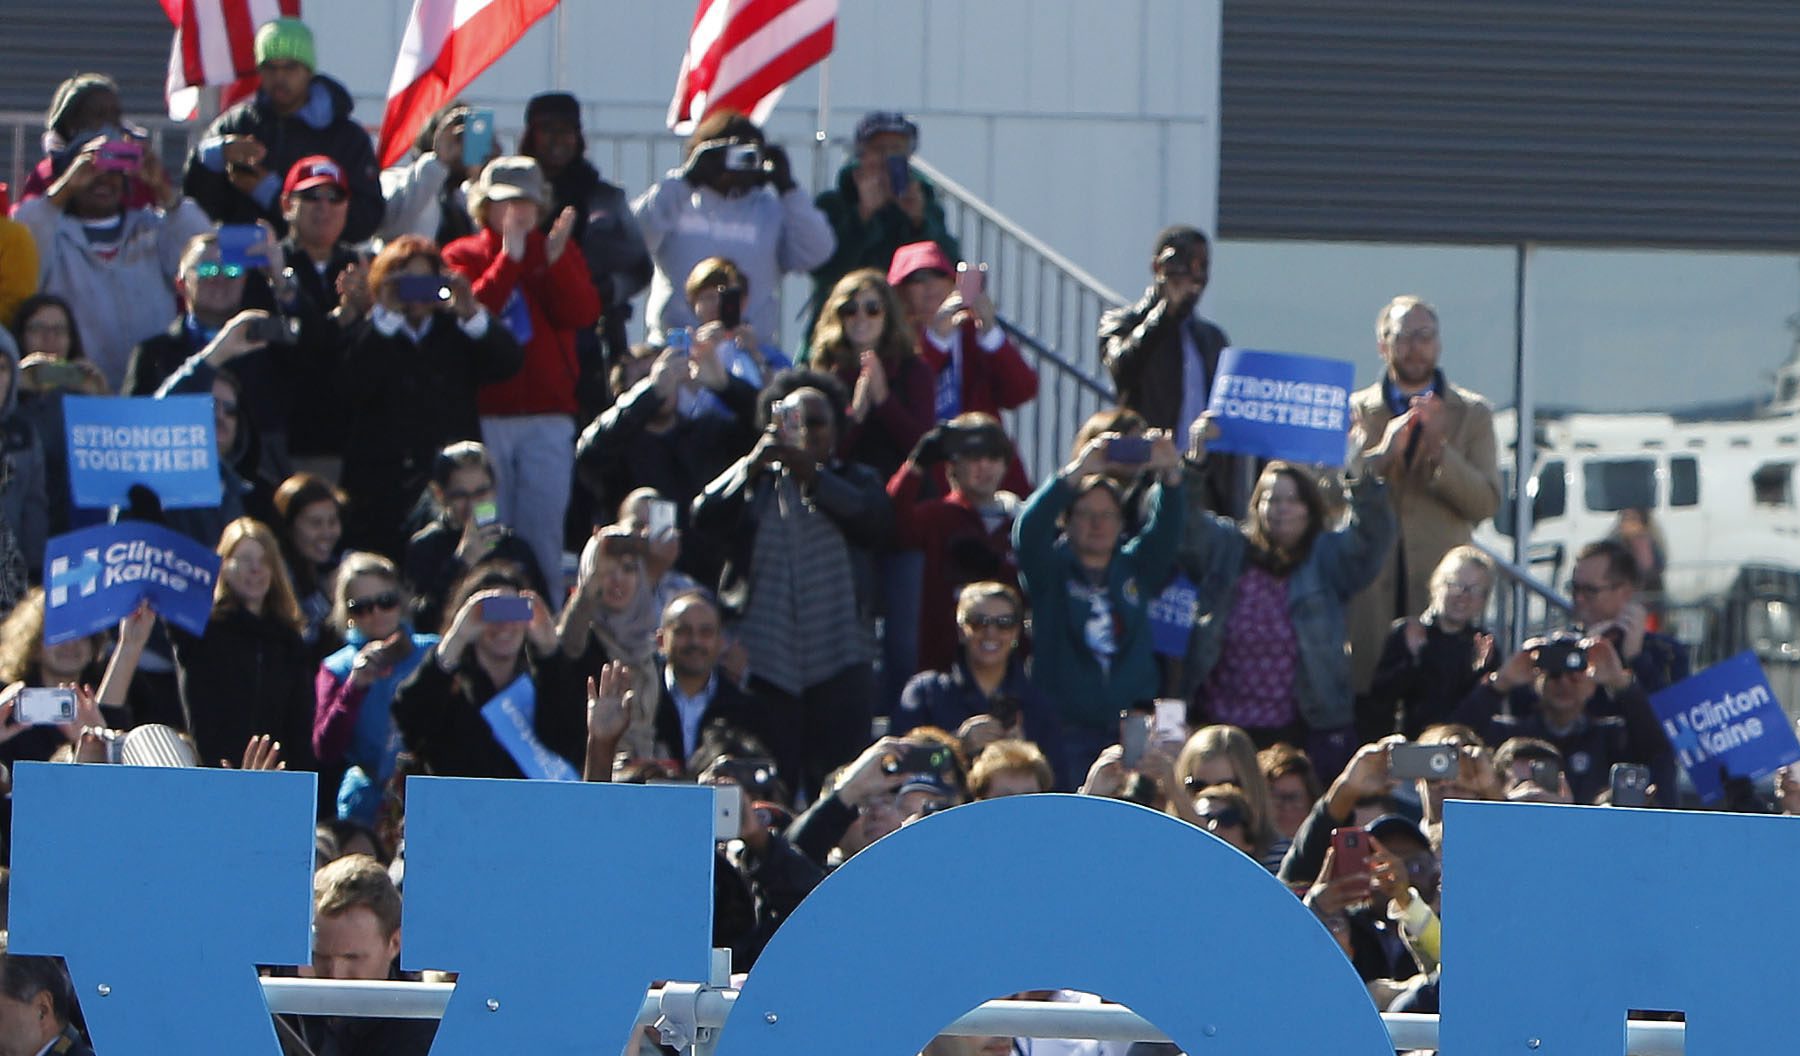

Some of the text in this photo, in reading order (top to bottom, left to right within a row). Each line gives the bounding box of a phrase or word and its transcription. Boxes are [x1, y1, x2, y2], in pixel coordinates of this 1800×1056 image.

[1213, 375, 1348, 407] STRONGER
[73, 424, 208, 448] STRONGER
[74, 448, 209, 472] TOGETHER
[104, 540, 212, 586] Clinton
[104, 560, 189, 593] Kaine
[1689, 685, 1770, 732] Clinton
[1698, 716, 1764, 756] Kaine
